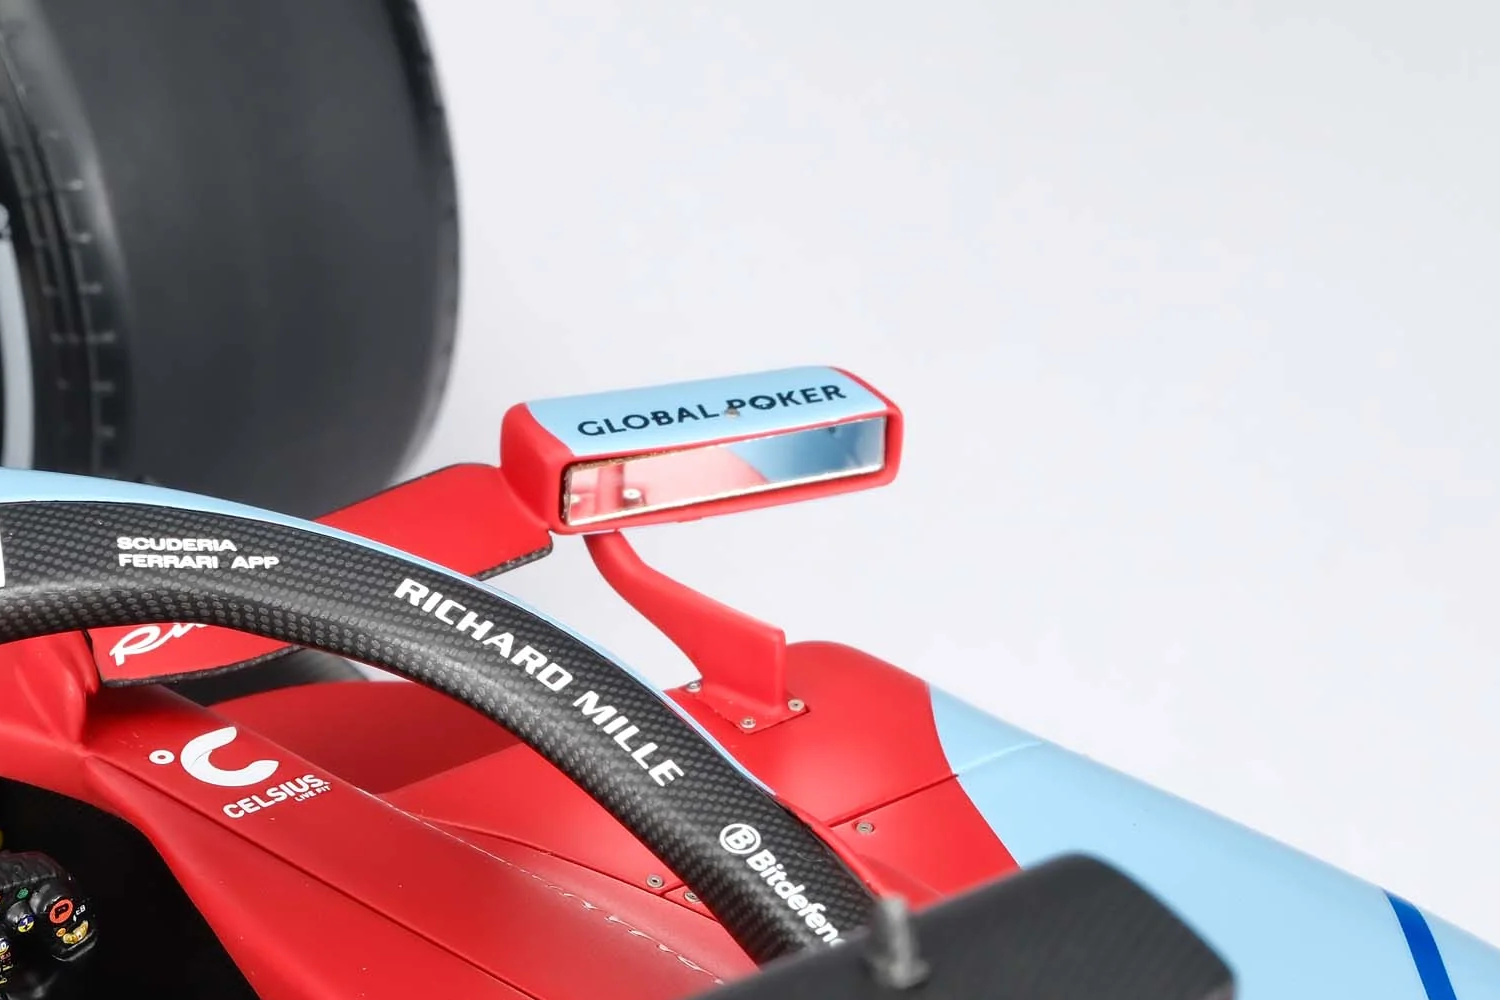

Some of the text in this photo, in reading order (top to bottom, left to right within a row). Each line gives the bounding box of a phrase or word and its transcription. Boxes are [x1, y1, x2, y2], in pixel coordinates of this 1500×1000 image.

[577, 384, 846, 438] GLOBAL POKER
[117, 537, 238, 551] SCUDERIA
[118, 553, 279, 569] FERRARI APP
[394, 578, 684, 787] RICHARD MILLE
[295, 784, 331, 802] LIVE FIT
